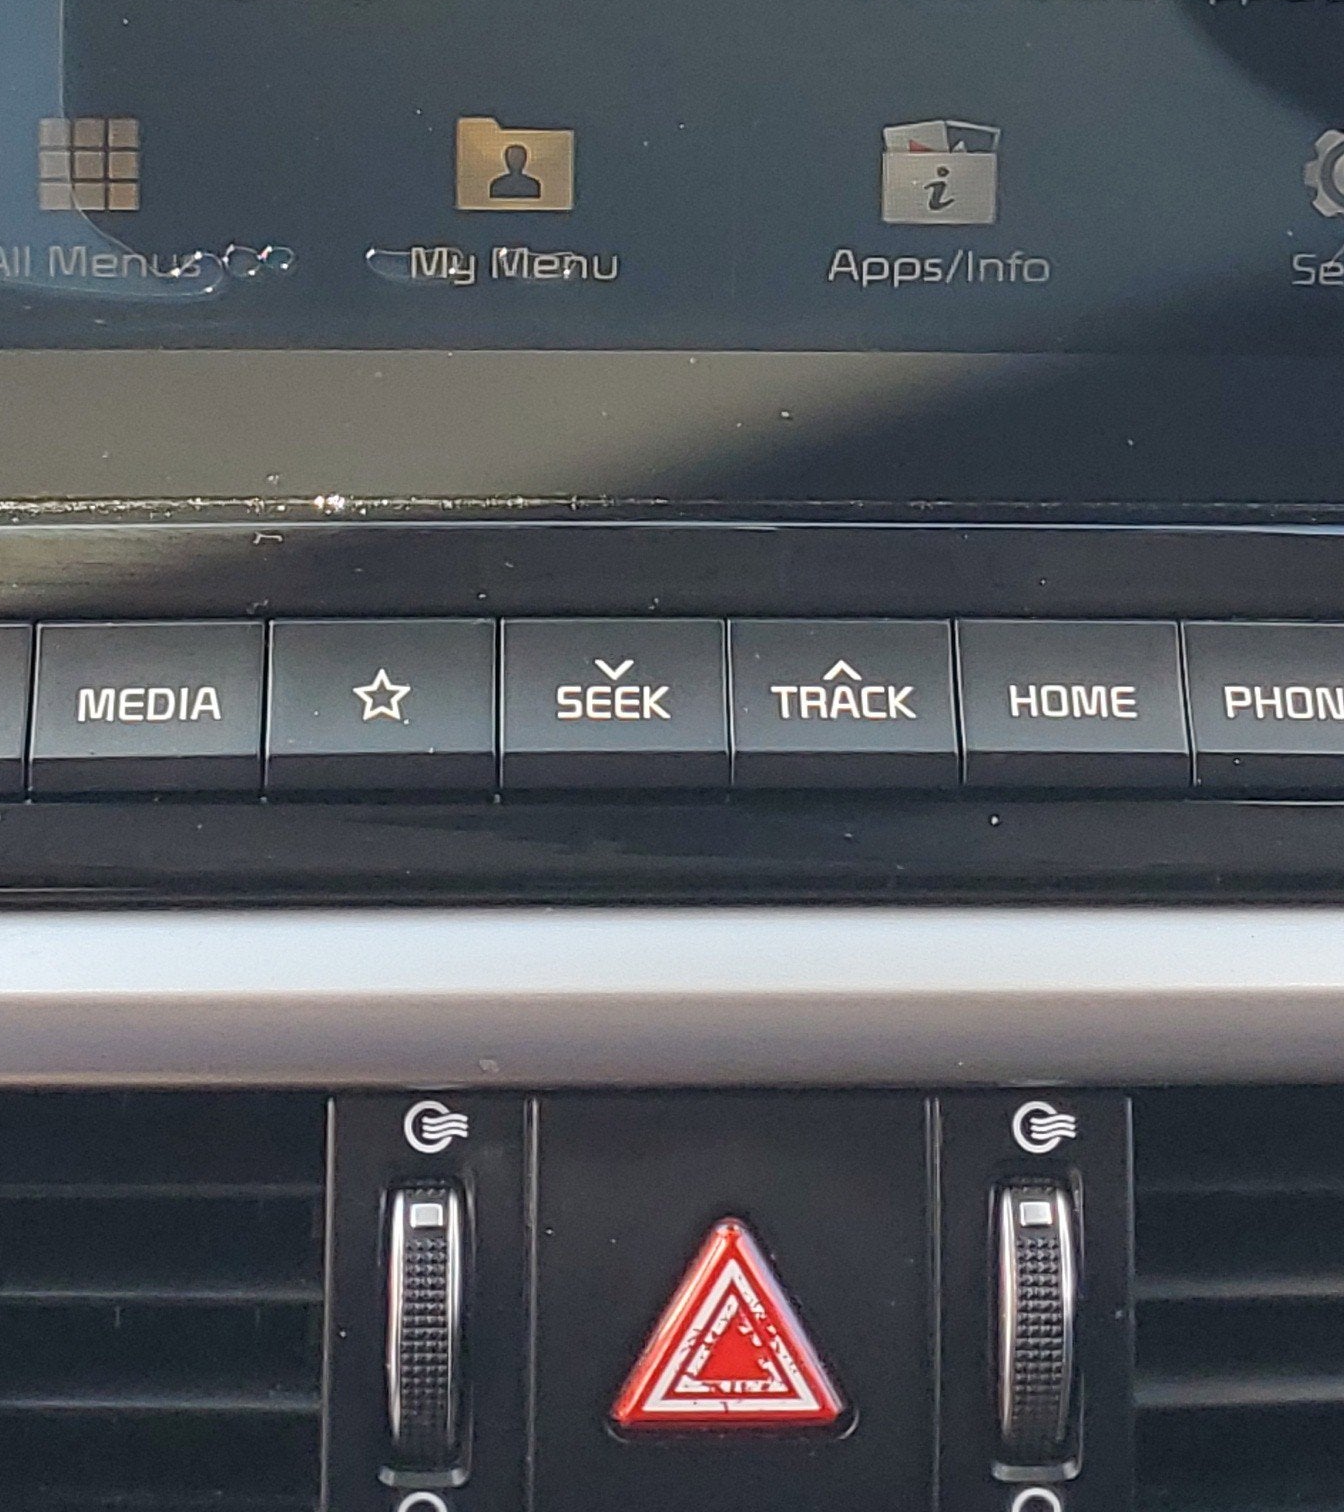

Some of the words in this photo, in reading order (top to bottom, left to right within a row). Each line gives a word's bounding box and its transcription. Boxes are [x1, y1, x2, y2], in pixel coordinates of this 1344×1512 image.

[48, 245, 203, 279] Menus
[410, 245, 477, 285] My
[490, 245, 619, 281] Menu
[827, 248, 1052, 288] Apps/Info
[77, 687, 222, 723] MEDIA
[556, 685, 672, 720] SEEK
[770, 684, 918, 720] TRACK
[1009, 684, 1139, 719] HOME
